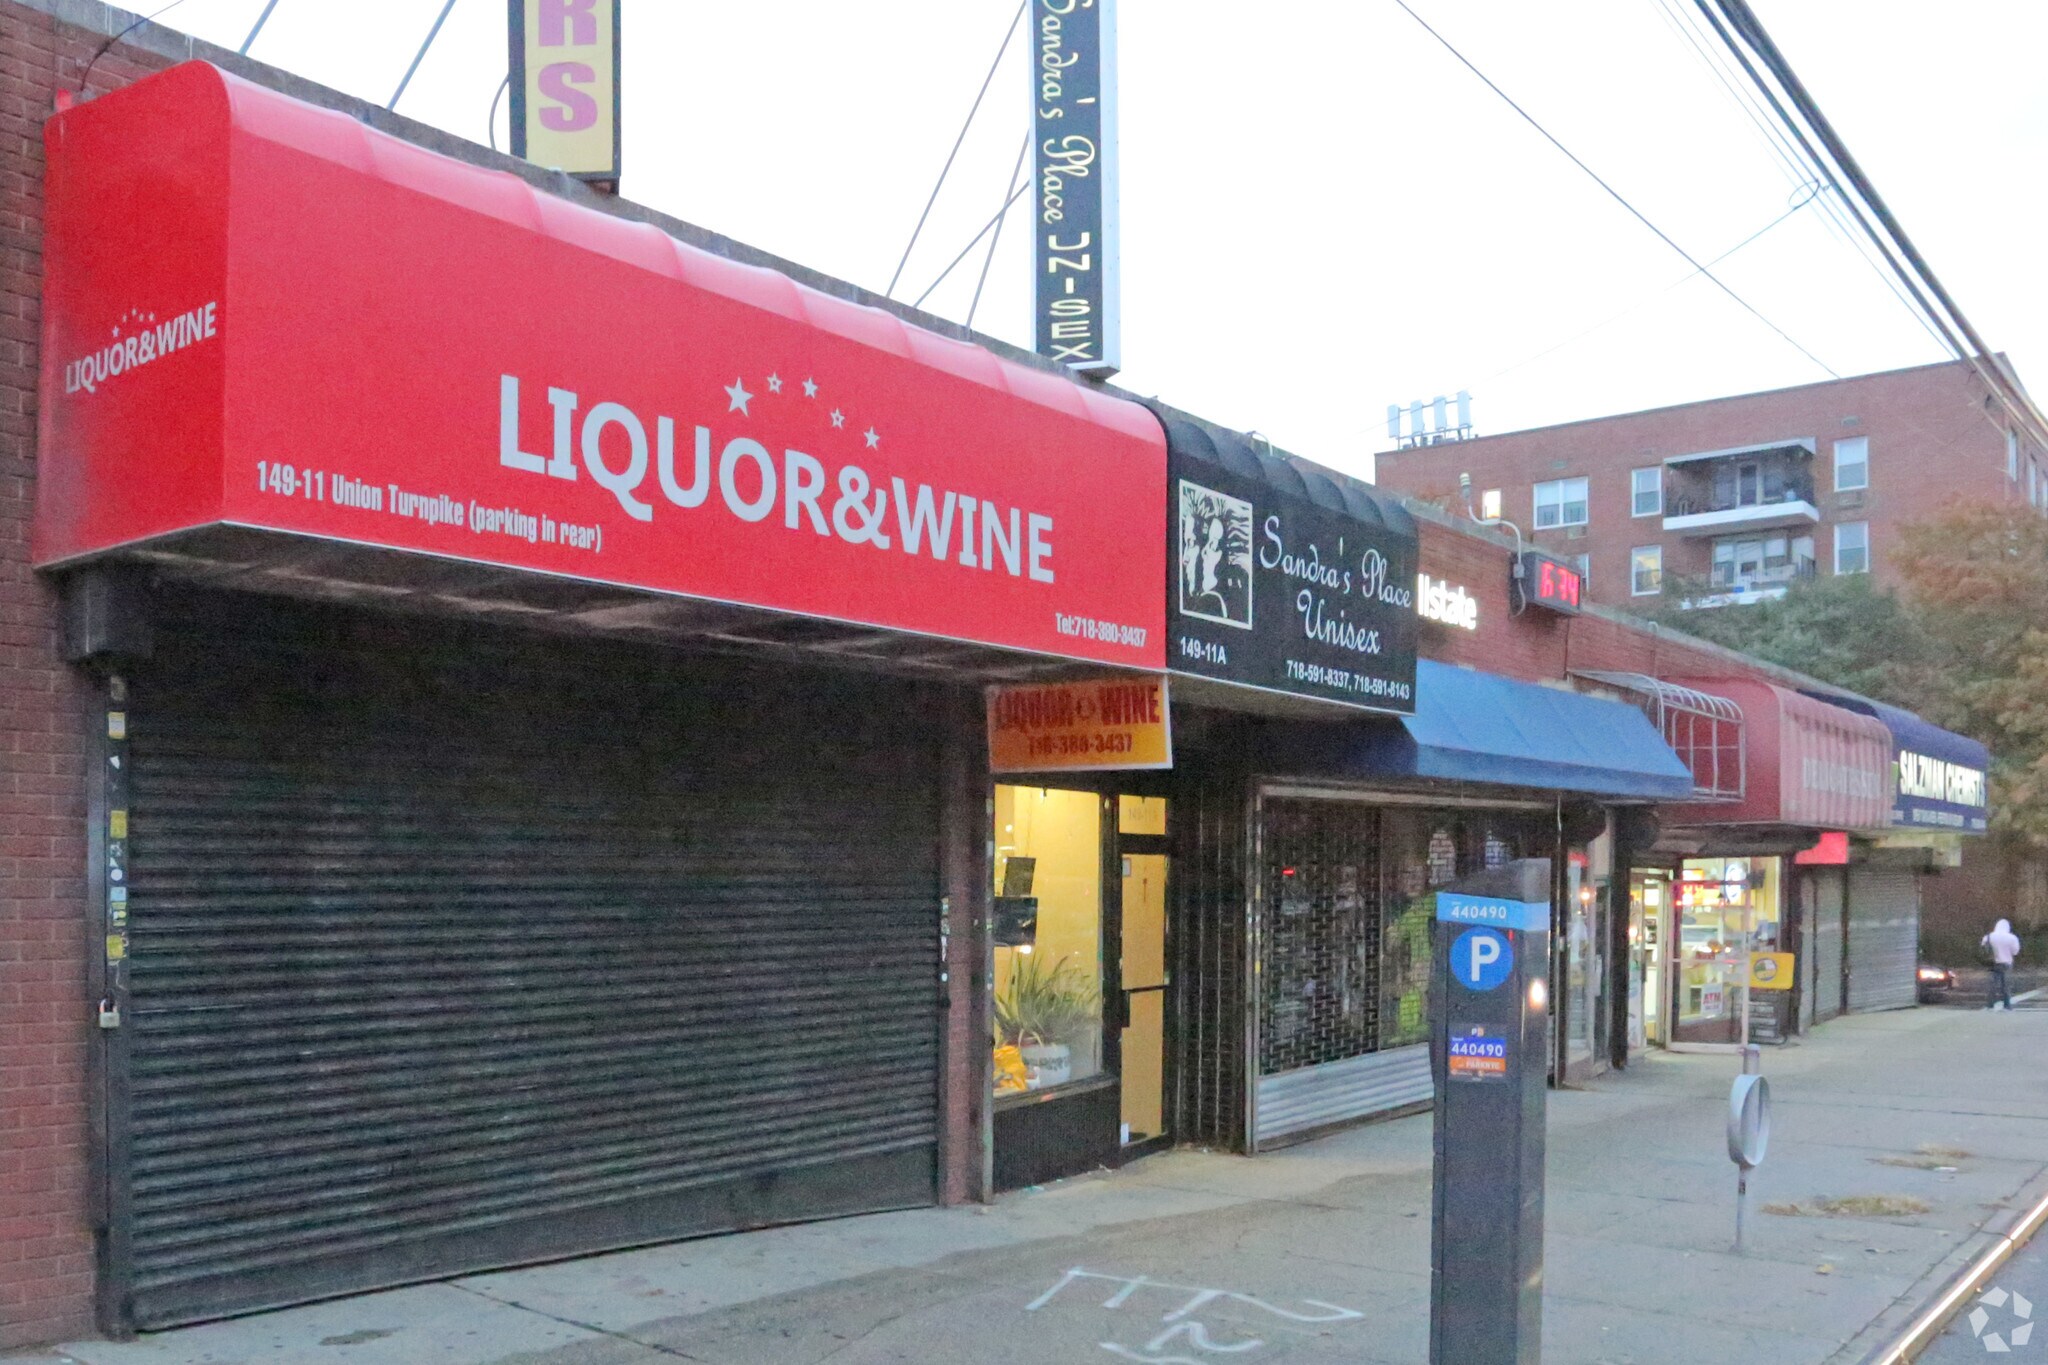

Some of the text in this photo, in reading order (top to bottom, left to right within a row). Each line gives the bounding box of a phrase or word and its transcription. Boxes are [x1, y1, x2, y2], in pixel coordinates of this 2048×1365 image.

[1043, 134, 1095, 224] Place
[1048, 232, 1093, 361] UNISEX
[65, 301, 216, 393] LIQUOR&WINE
[256, 460, 602, 554] 149-11 Union Turnpike (parking in rear)
[500, 374, 1055, 584] LIQUOR&WINE
[1260, 515, 1412, 608] Sandra's Place
[1180, 636, 1226, 665] 149-11A
[1296, 589, 1381, 655] Unisex
[1099, 684, 1160, 726] WINE
[1354, 675, 1410, 700] 718-591-8143
[1451, 905, 1507, 920] 440490
[1471, 936, 1500, 982] P
[1451, 1042, 1503, 1057] 440490
